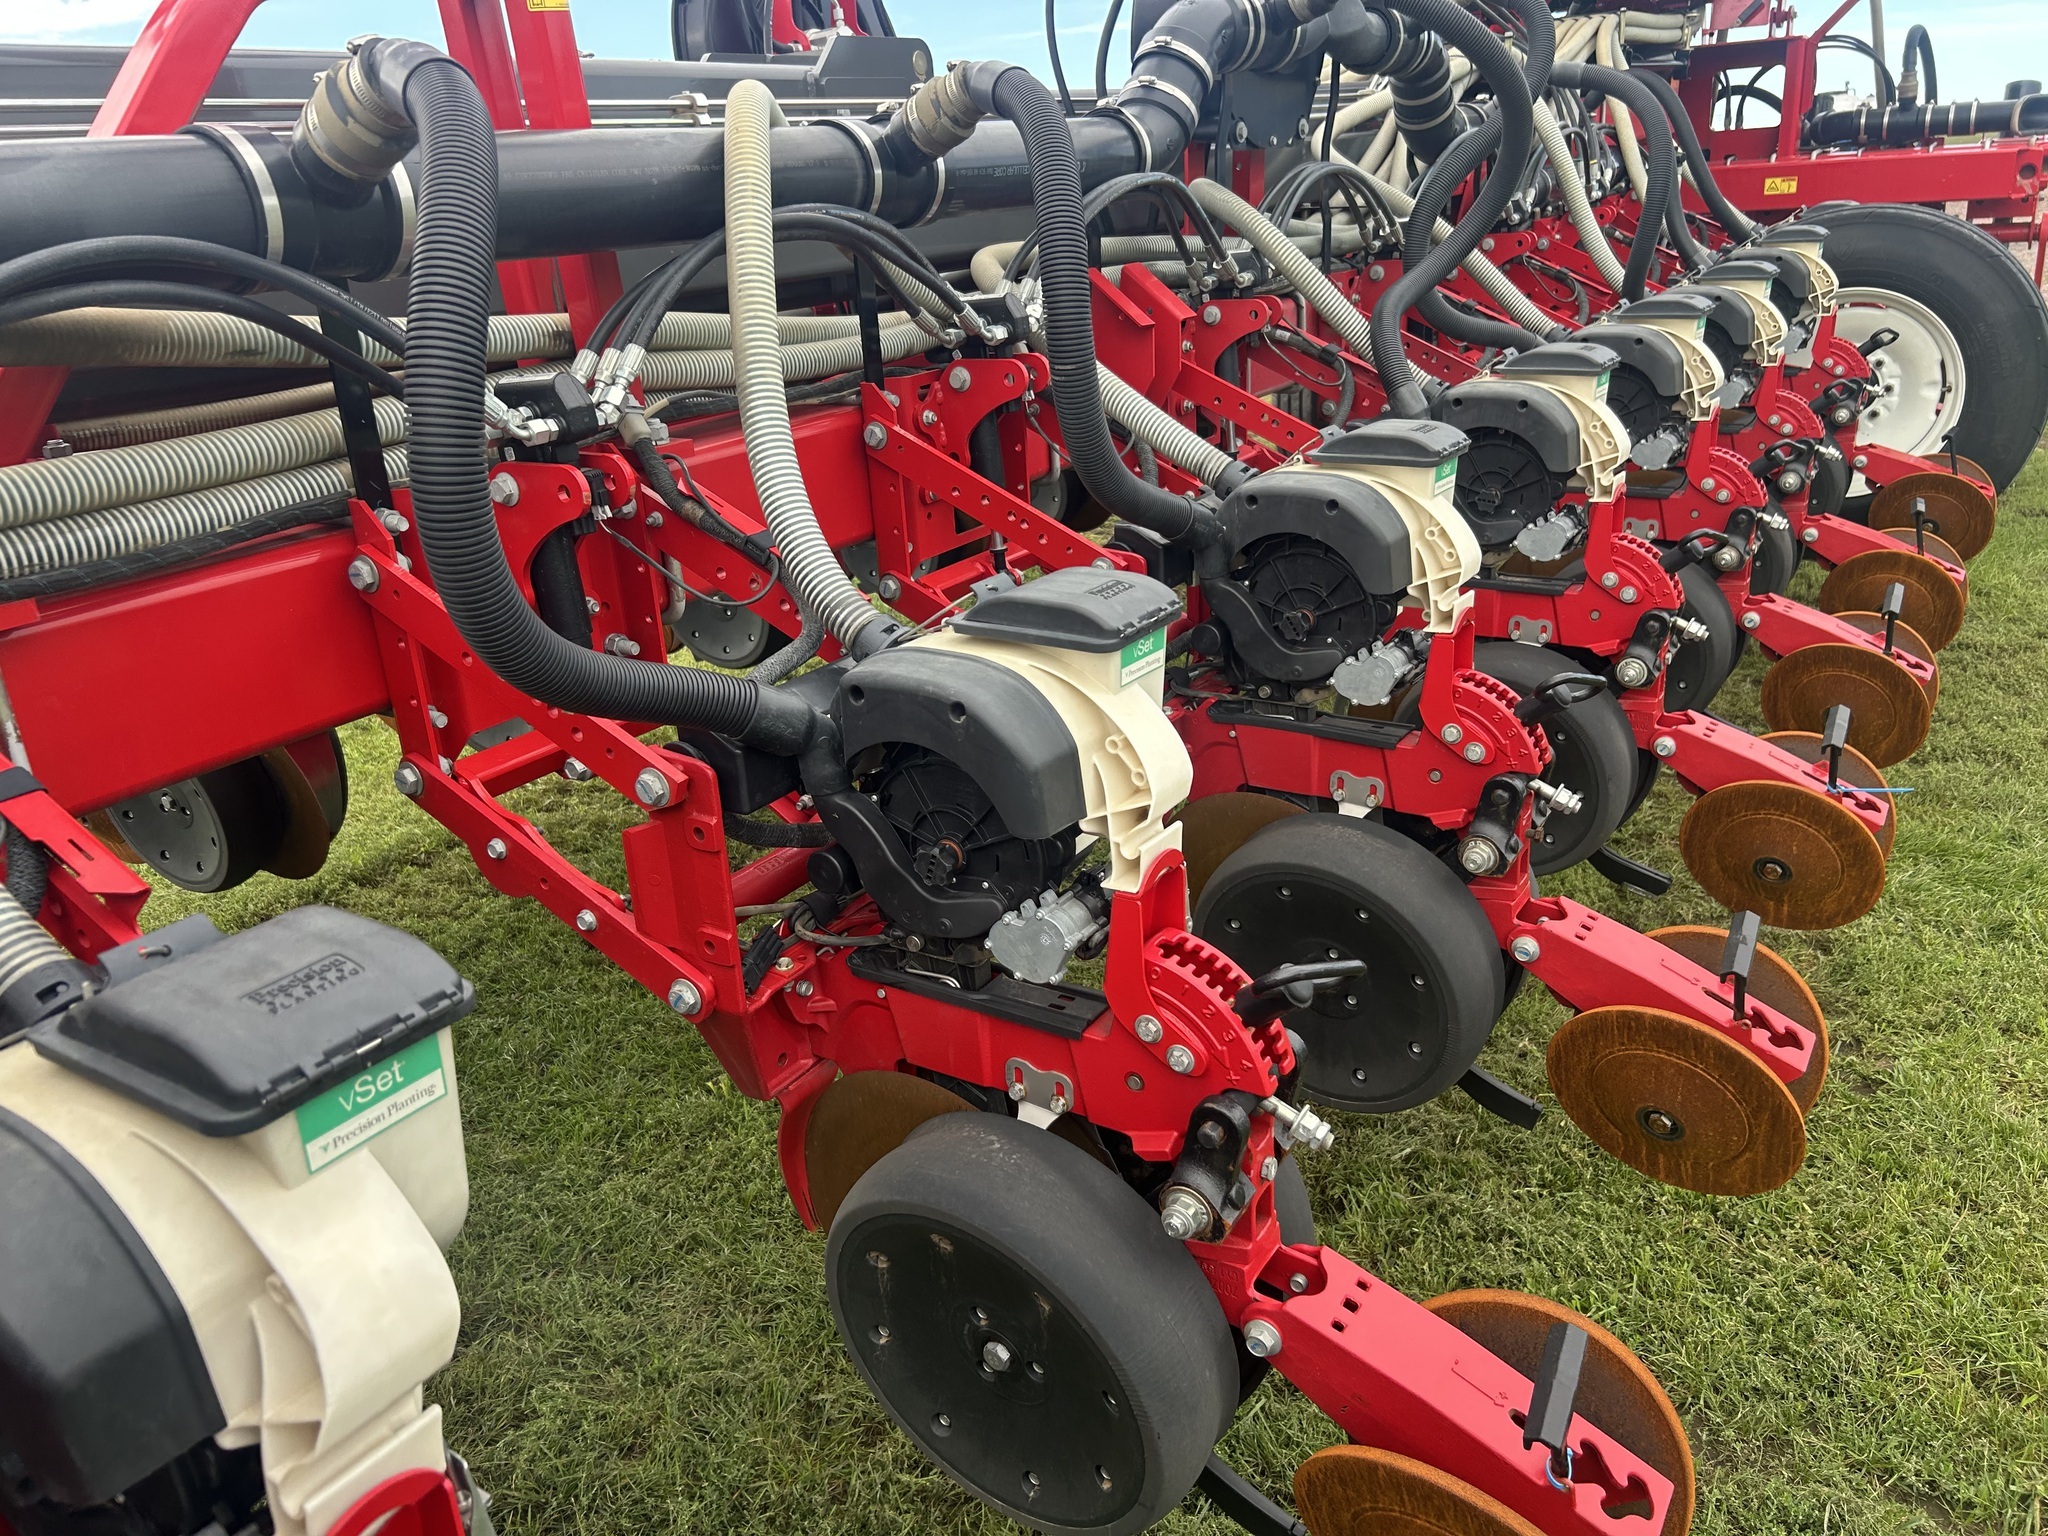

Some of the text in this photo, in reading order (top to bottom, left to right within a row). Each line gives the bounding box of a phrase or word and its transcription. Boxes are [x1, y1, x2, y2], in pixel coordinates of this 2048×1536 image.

[1133, 636, 1155, 658] vSet
[338, 1060, 405, 1112] vSet
[332, 1084, 436, 1149] Precision Planting
